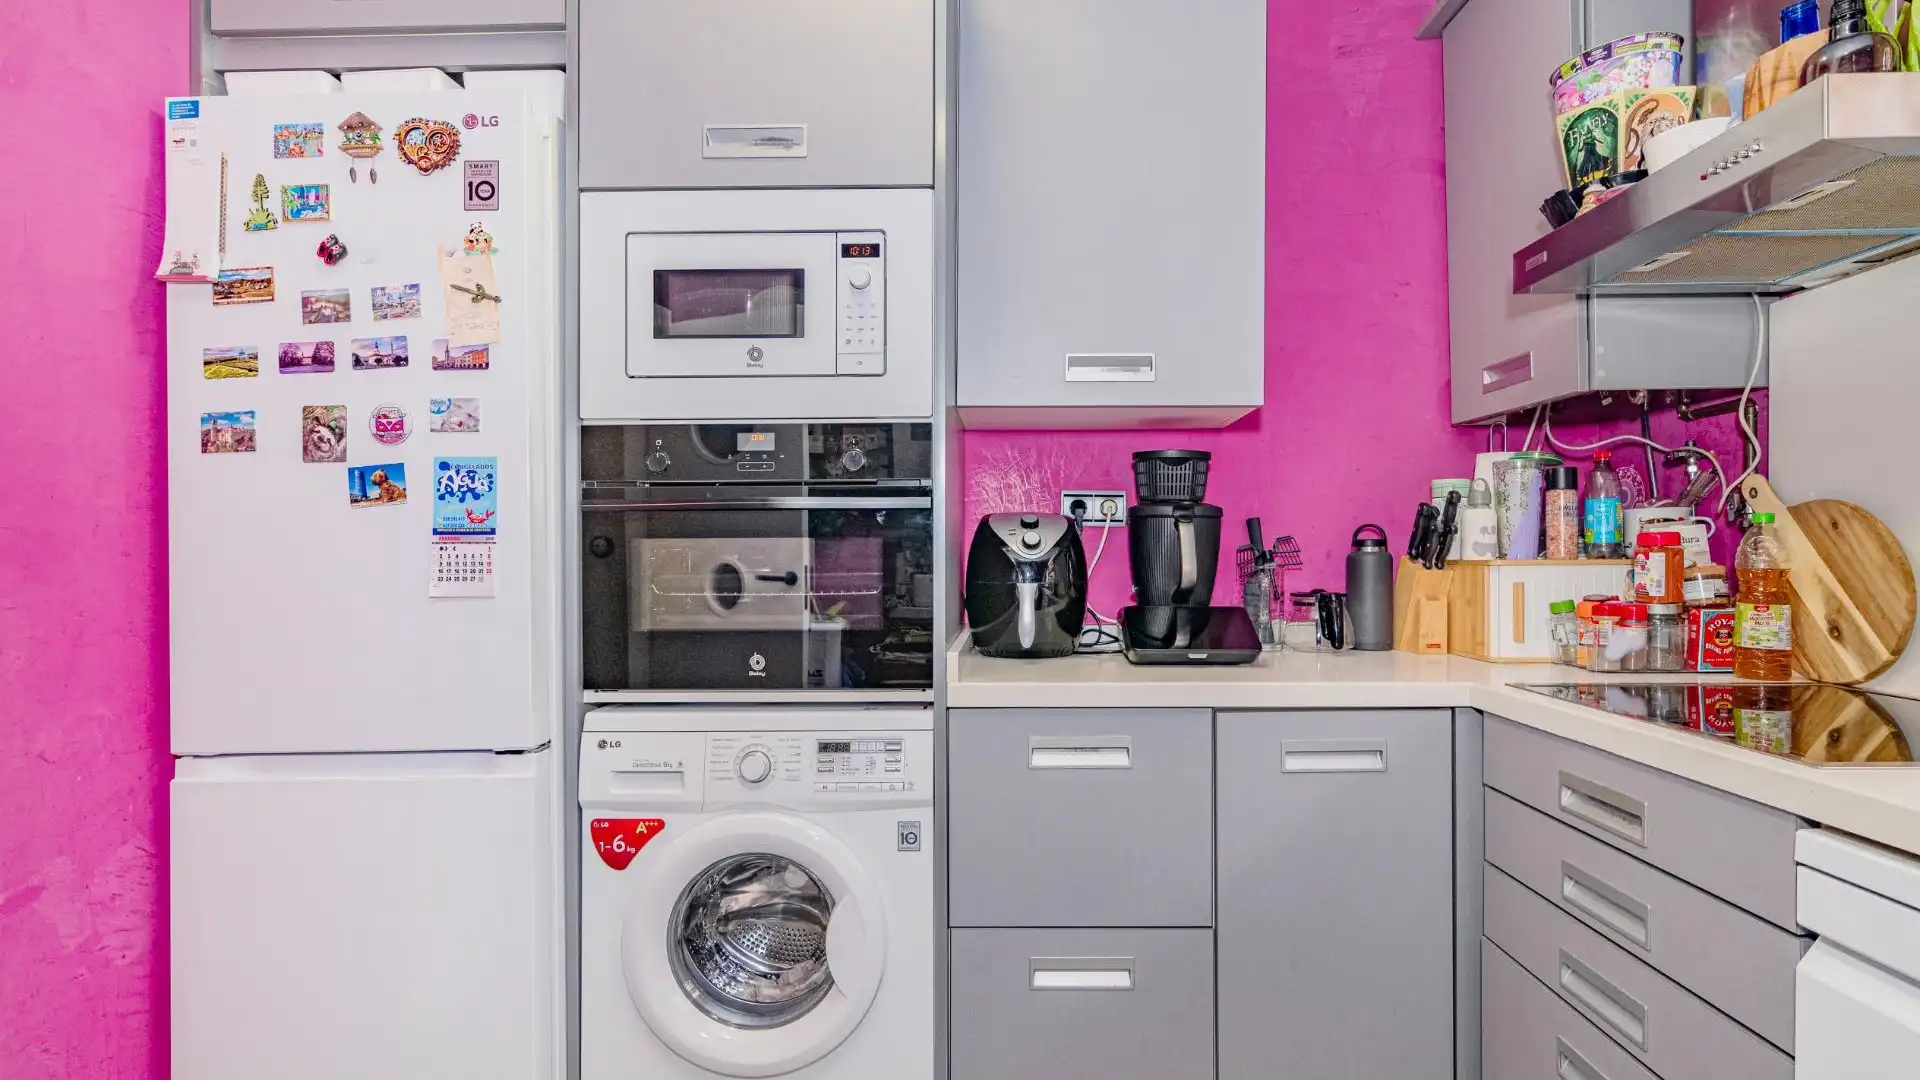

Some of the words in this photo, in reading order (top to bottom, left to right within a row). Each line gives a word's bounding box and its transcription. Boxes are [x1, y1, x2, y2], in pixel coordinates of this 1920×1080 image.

[481, 116, 499, 127] LG
[468, 181, 496, 201] 10
[1707, 619, 1735, 632] ROYA
[900, 831, 918, 845] 10
[626, 845, 636, 854] kg
